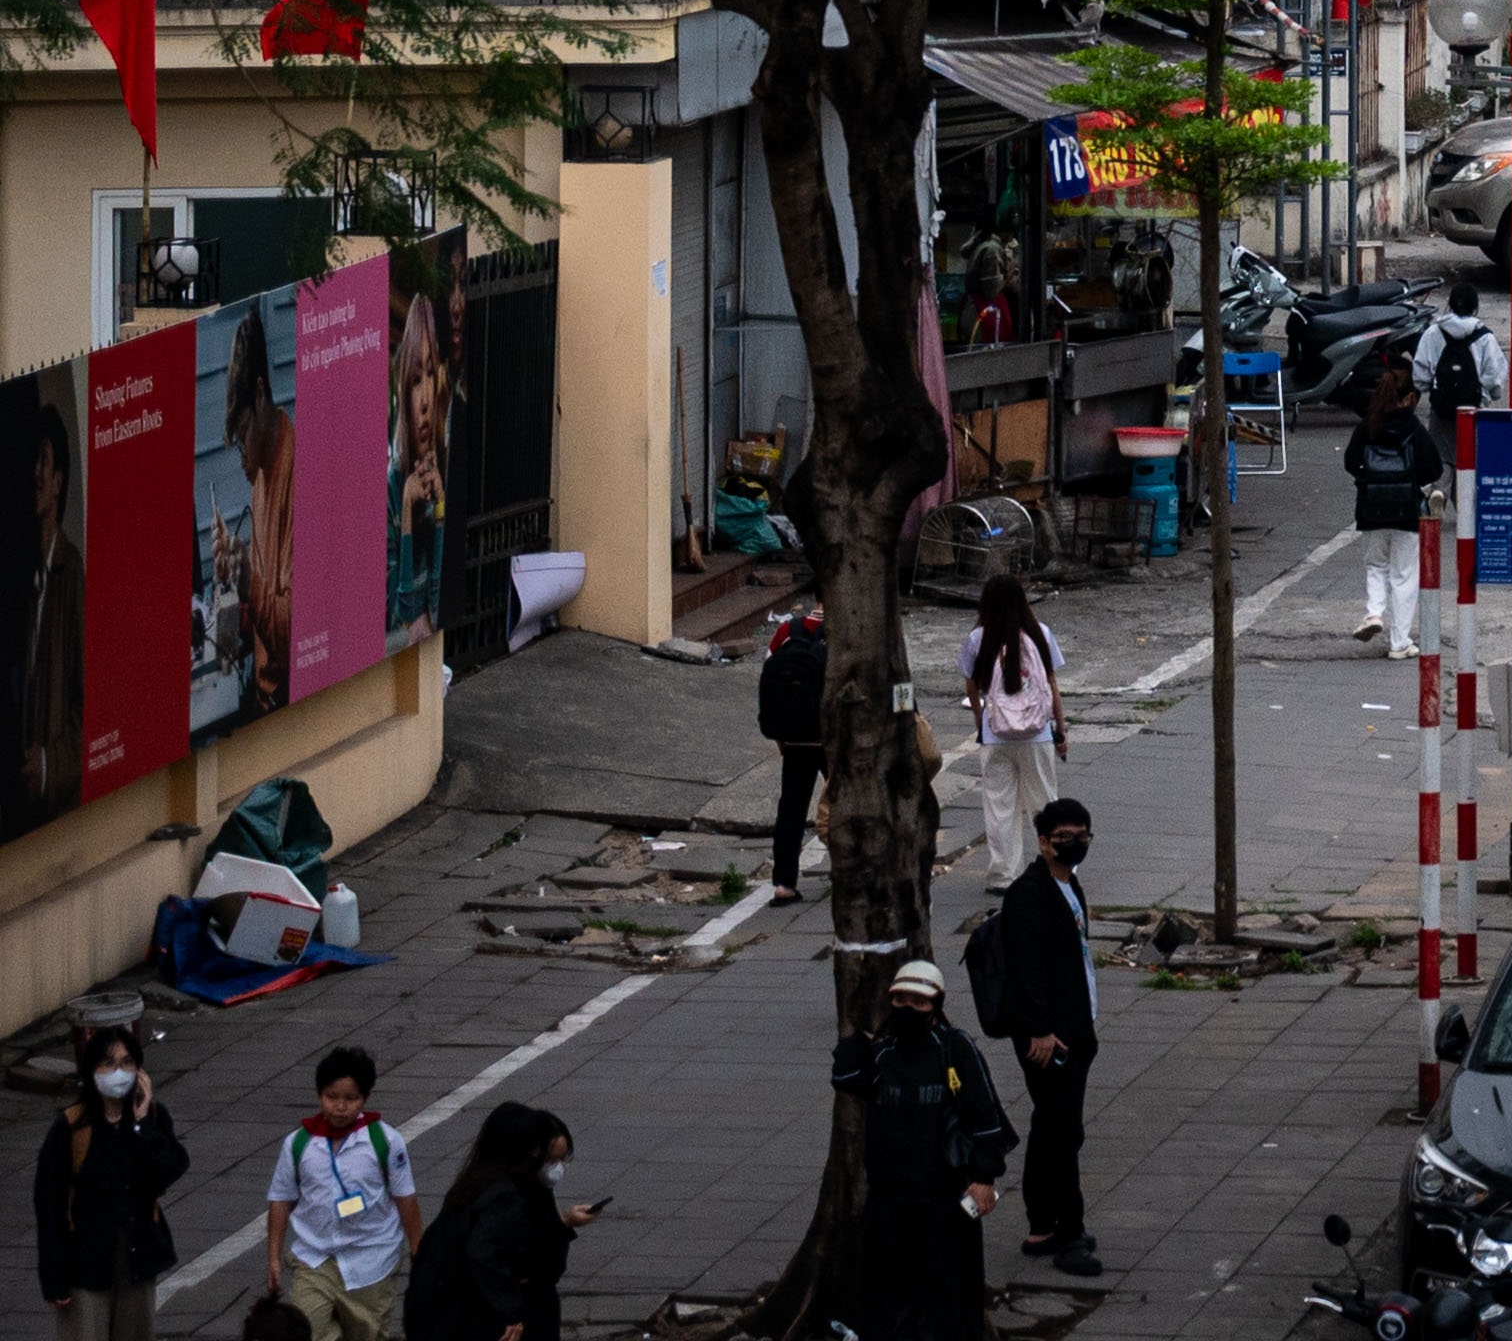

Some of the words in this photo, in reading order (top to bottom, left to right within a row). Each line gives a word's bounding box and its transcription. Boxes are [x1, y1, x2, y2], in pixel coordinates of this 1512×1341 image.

[1049, 134, 1085, 183] 173
[95, 382, 126, 411] Shaping
[125, 376, 154, 400] Futures
[95, 424, 113, 449] from
[113, 418, 142, 443] Eastern
[142, 409, 163, 433] Roots
